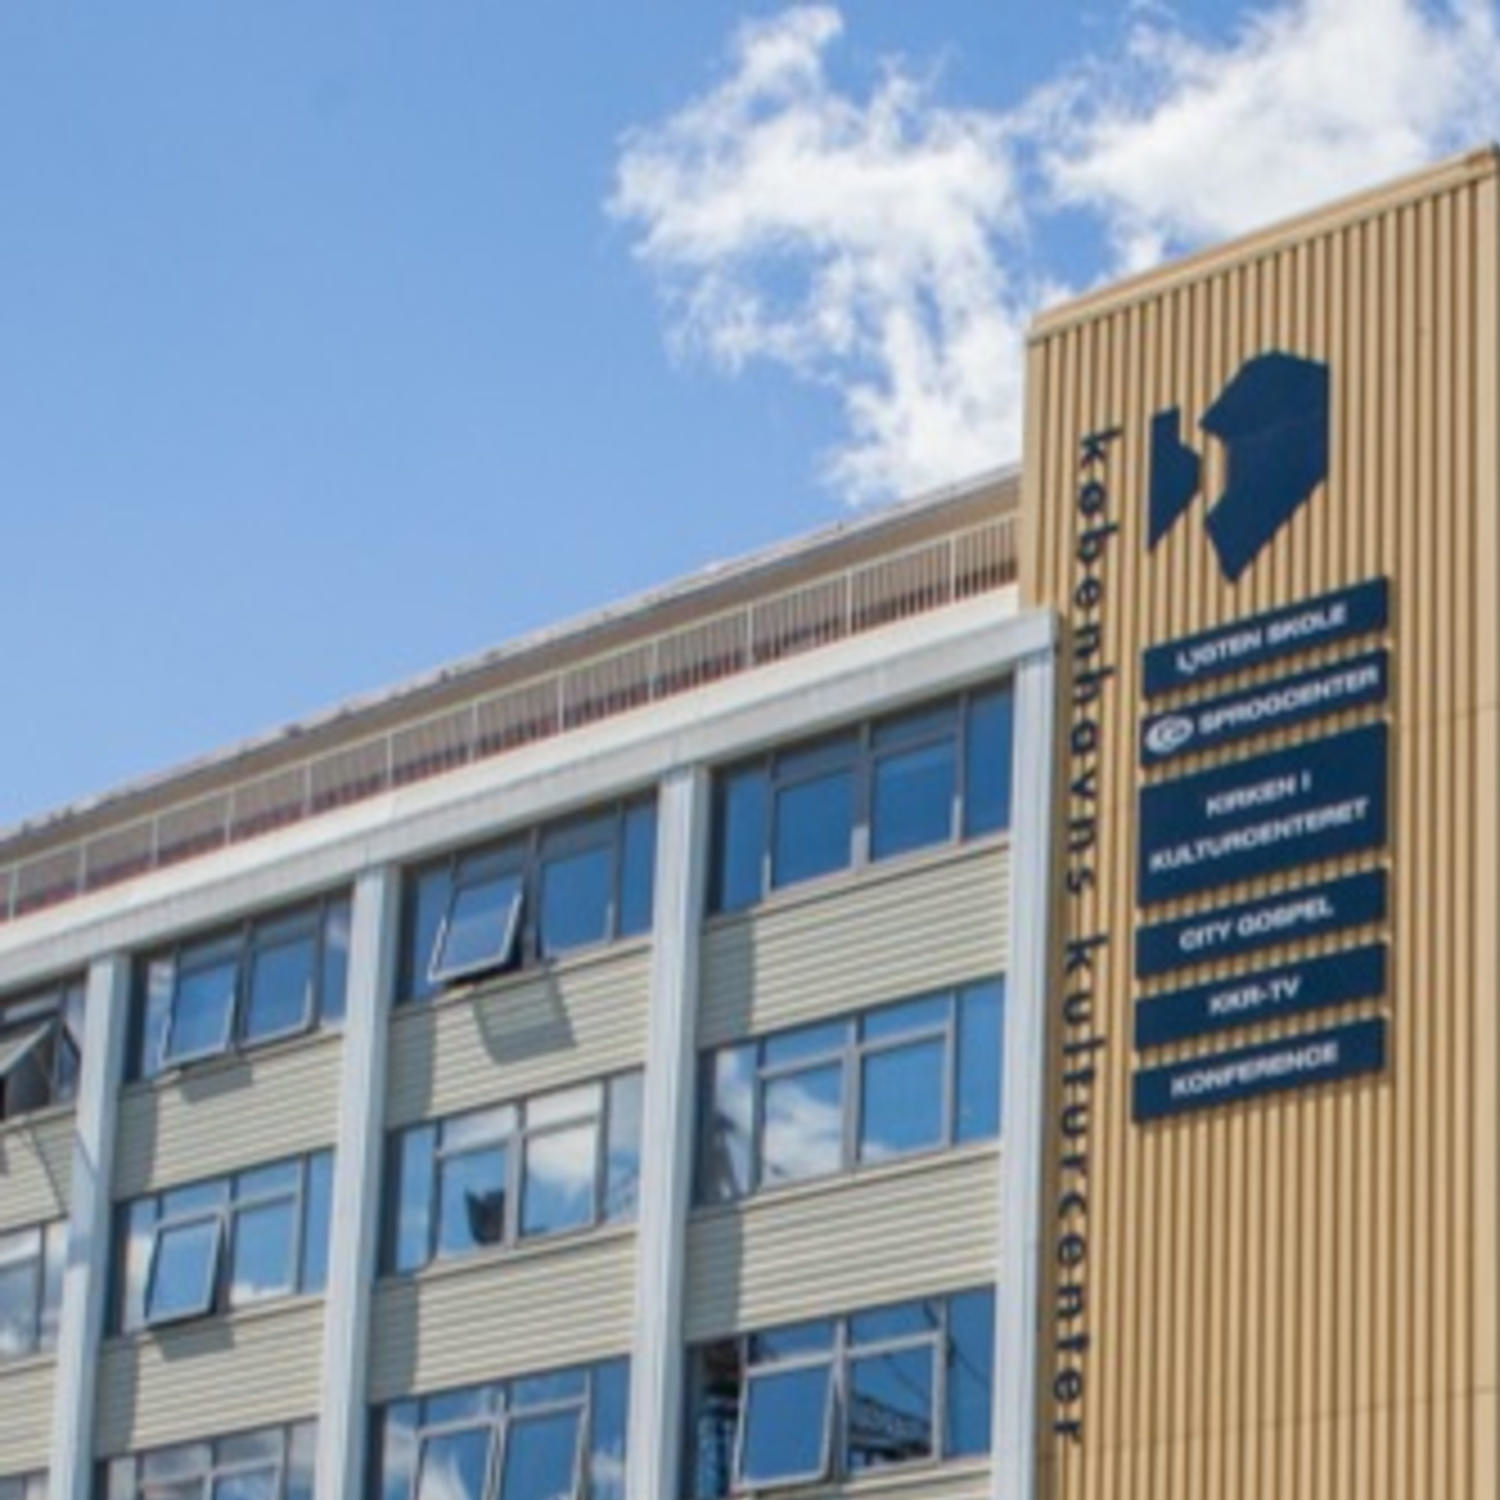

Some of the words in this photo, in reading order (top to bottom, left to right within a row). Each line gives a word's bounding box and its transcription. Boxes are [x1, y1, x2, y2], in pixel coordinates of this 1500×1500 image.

[1266, 601, 1347, 645] SKOLE
[1067, 427, 1122, 895] københavns
[1200, 664, 1379, 734] SPROGCENTER
[1206, 774, 1297, 818] KIRKEN
[1150, 796, 1369, 872] KULTURCENTERET
[1179, 919, 1233, 951] CITY
[1237, 896, 1335, 936] GOSPEL
[1170, 1041, 1340, 1098] KONFERENCE
[1053, 933, 1108, 1443] kulturcenter
